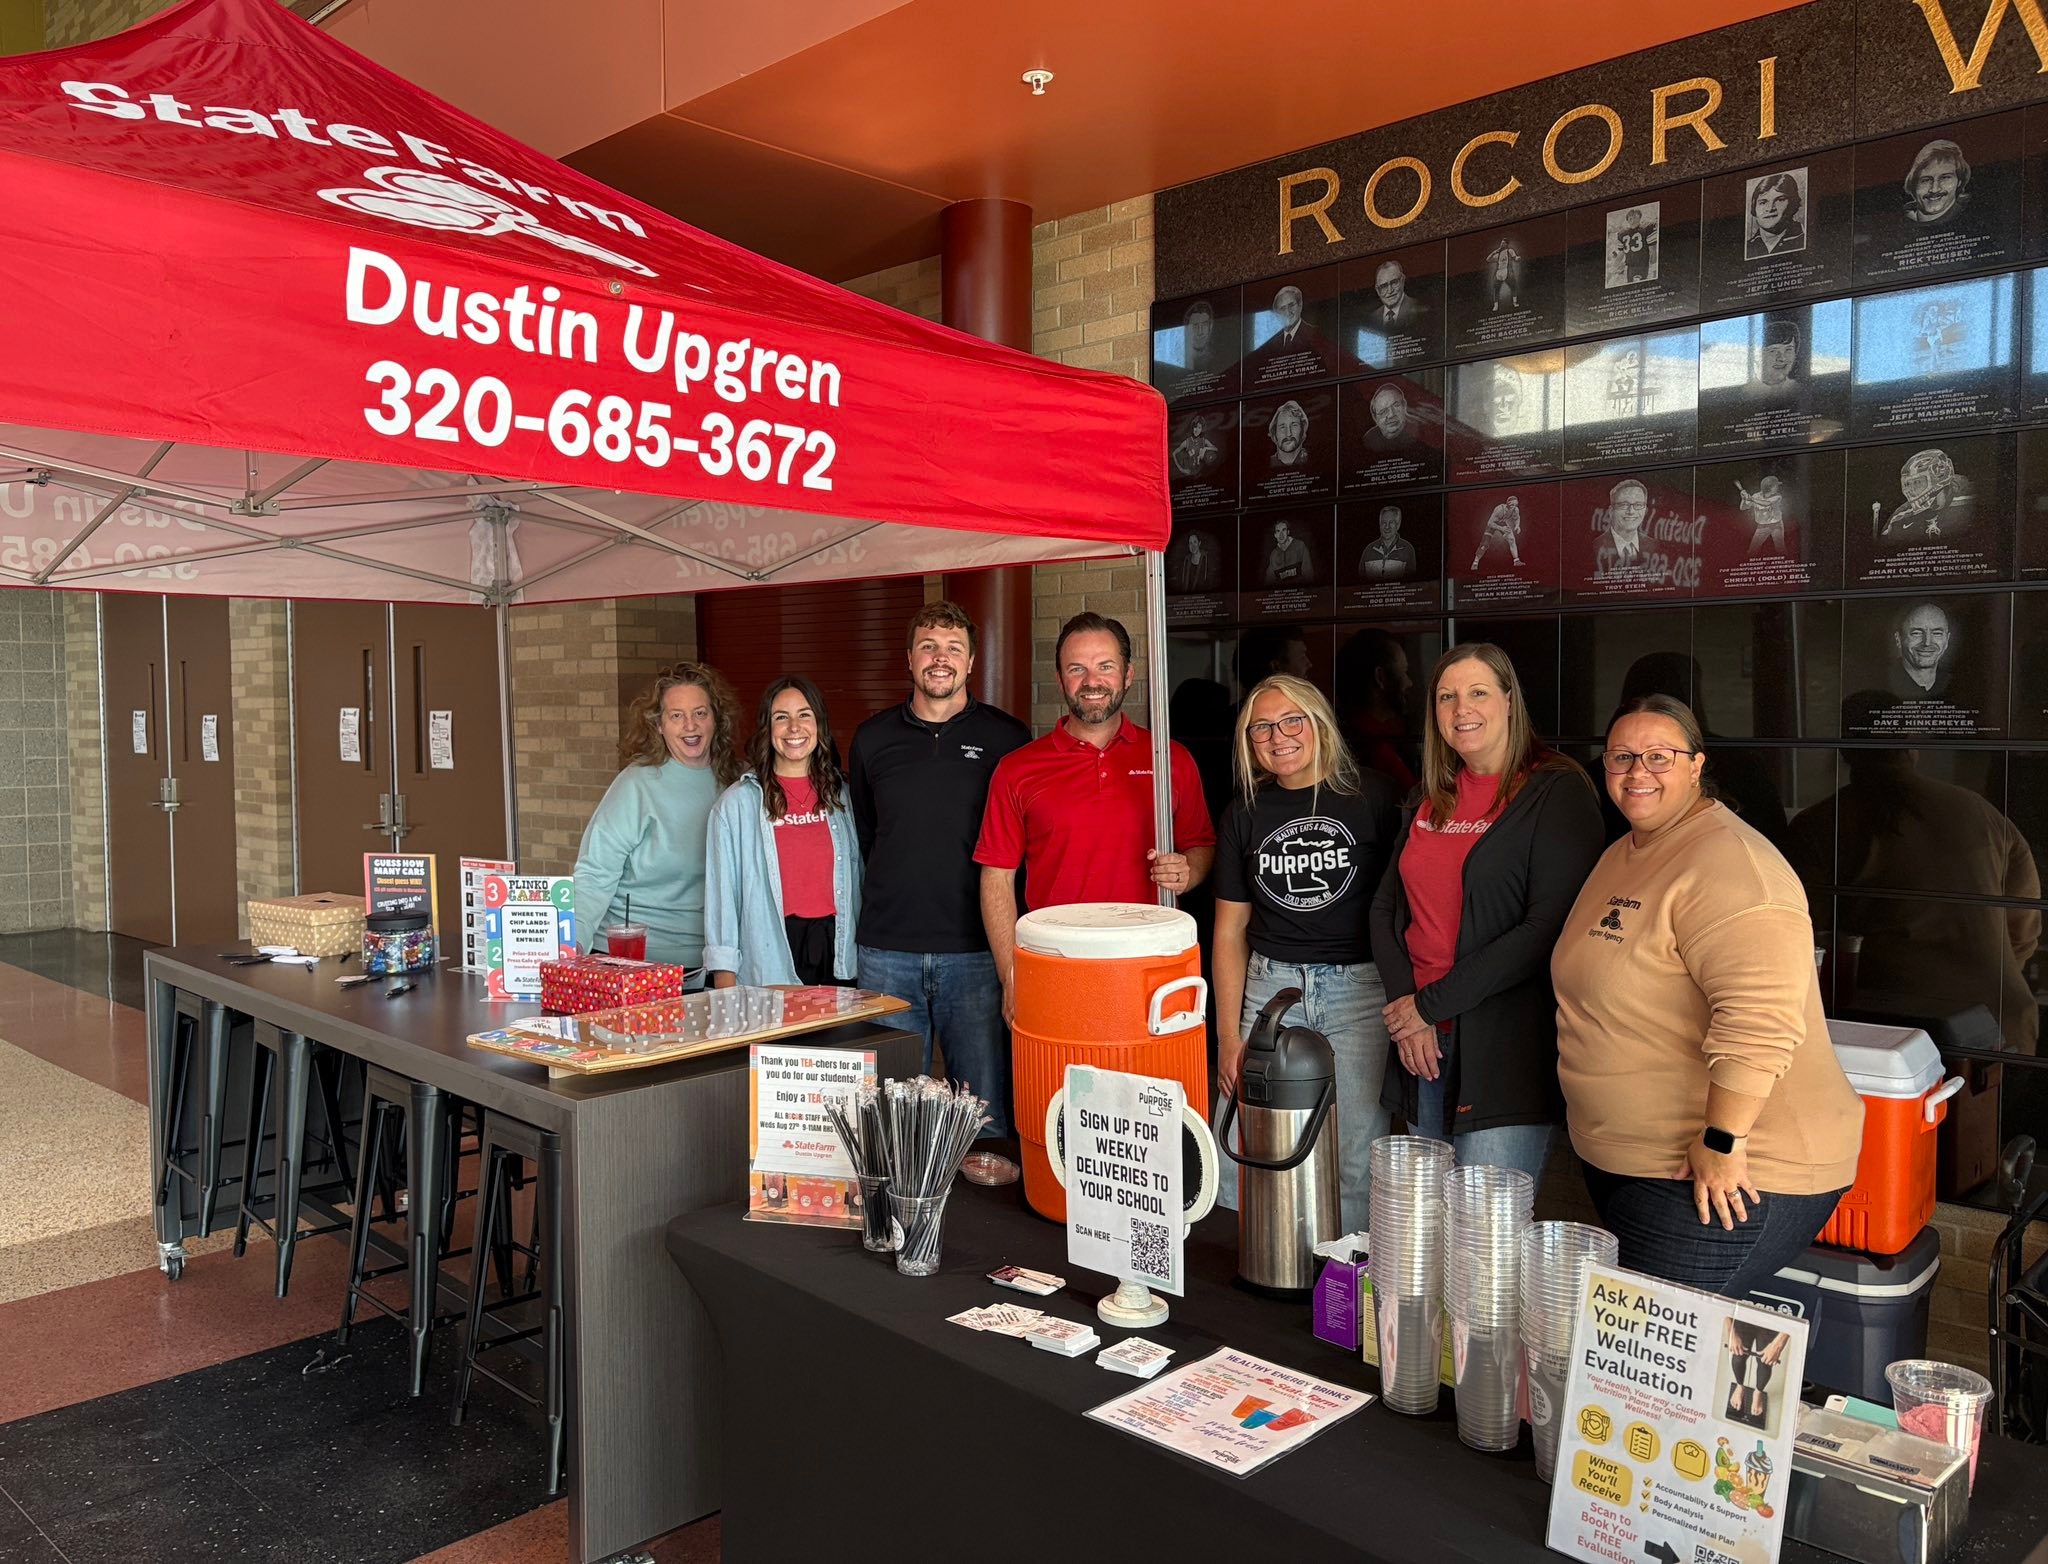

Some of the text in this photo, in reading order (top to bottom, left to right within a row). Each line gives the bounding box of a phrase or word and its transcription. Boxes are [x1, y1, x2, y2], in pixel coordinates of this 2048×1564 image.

[1278, 55, 1778, 256] ROCORI
[1899, 249, 1971, 266] RICK THEISEN
[1746, 278, 1803, 293] JEFF LUNDE
[345, 246, 842, 407] Dustin Upgren
[1890, 406, 1977, 421] JEFF MASSMANN
[363, 359, 836, 491] 320-685-3672
[1898, 566, 1930, 574] (VOGT)
[1933, 563, 1988, 572] DICKERMAN
[1274, 826, 1299, 843] HEALTHY
[1300, 823, 1313, 833] EATS
[1319, 823, 1339, 837] DRINKS
[374, 859, 401, 867] GUESS
[374, 867, 401, 875] MANY
[1259, 848, 1351, 875] PURPOSE
[487, 883, 571, 902] 3 GAME 2
[509, 880, 548, 890] PLINKO
[486, 913, 497, 932] 1
[559, 919, 571, 941] 1
[492, 947, 502, 961] 2
[761, 1056, 862, 1070] Thank you TEA-chers for all
[766, 1070, 857, 1084] you do for our students!
[776, 1091, 798, 1103] Enjoy
[801, 1094, 805, 1102] a
[807, 1093, 822, 1104] TEA
[1139, 1092, 1173, 1109] PURPOSE
[774, 1111, 783, 1119] ALL
[805, 1113, 820, 1121] STAFF
[777, 1122, 787, 1130] Aug
[802, 1123, 822, 1132] 9-11AM
[1080, 1109, 1159, 1143] SIGN UP FOR
[1096, 1136, 1148, 1163] WEEKLY
[1077, 1155, 1169, 1192] DELIVERIES TO
[1080, 1179, 1166, 1216] YOUR SCHOOL
[1076, 1223, 1111, 1242] SCAN HERE
[1593, 1284, 1698, 1329] Ask About
[1593, 1305, 1697, 1353] Your FREE
[1596, 1329, 1687, 1373] Wellness
[1226, 1354, 1352, 1402] HEALTHY ENERGY DRINKS
[1585, 1349, 1693, 1400] Evaluation
[1587, 1372, 1706, 1419] Your Health, Your way Custom
[1593, 1383, 1697, 1425] Nutrition Plans for Optimal
[1624, 1402, 1662, 1421] Wellness!
[1589, 1455, 1619, 1475] What
[1588, 1467, 1618, 1488] You'll
[1579, 1477, 1622, 1502] Receive
[1654, 1495, 1704, 1521] Body Analysis
[1655, 1482, 1747, 1523] Accountability & Support
[1590, 1502, 1632, 1527] Scan to
[1581, 1511, 1638, 1542] Book Your
[1652, 1508, 1736, 1547] Personalized Meal Plan
[1577, 1536, 1635, 1564] Evaluation
[1594, 1529, 1622, 1549] FREE
